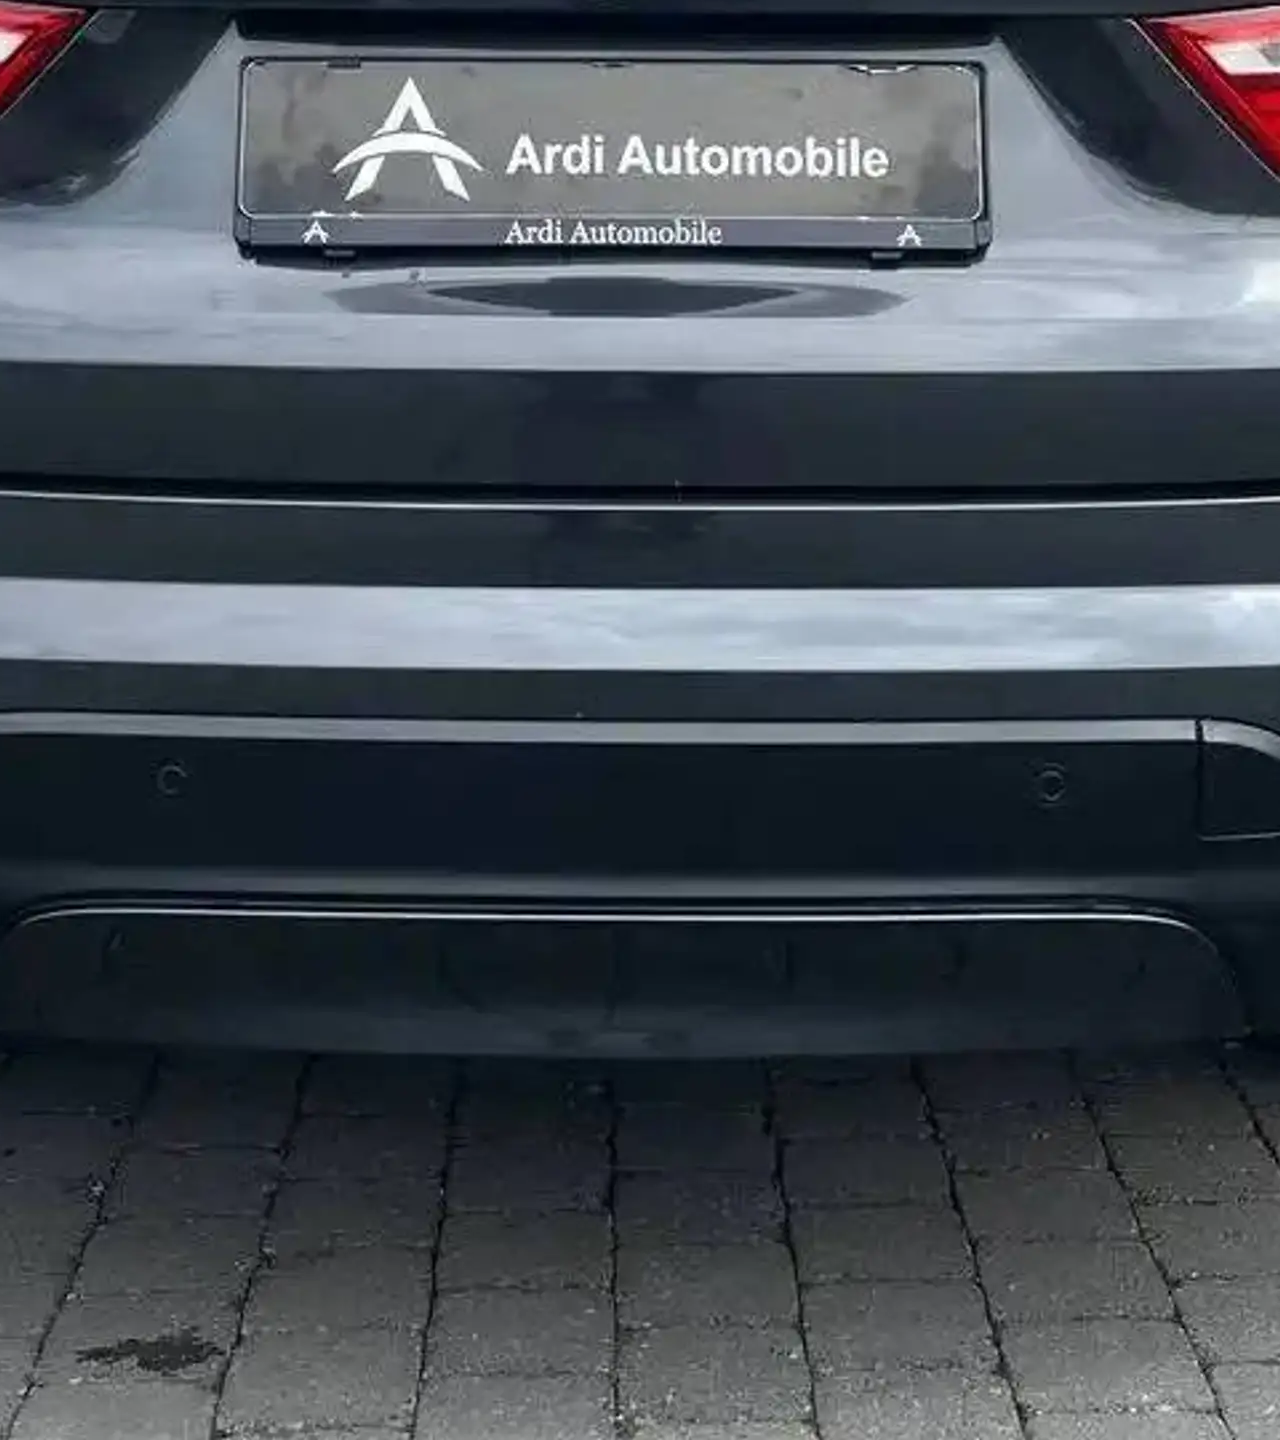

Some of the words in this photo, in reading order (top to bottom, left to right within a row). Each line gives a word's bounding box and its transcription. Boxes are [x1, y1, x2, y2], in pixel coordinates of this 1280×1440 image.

[506, 133, 606, 175] Ardi
[617, 134, 890, 177] Automobile
[504, 218, 562, 245] Ardi
[570, 216, 723, 246] Automobile
